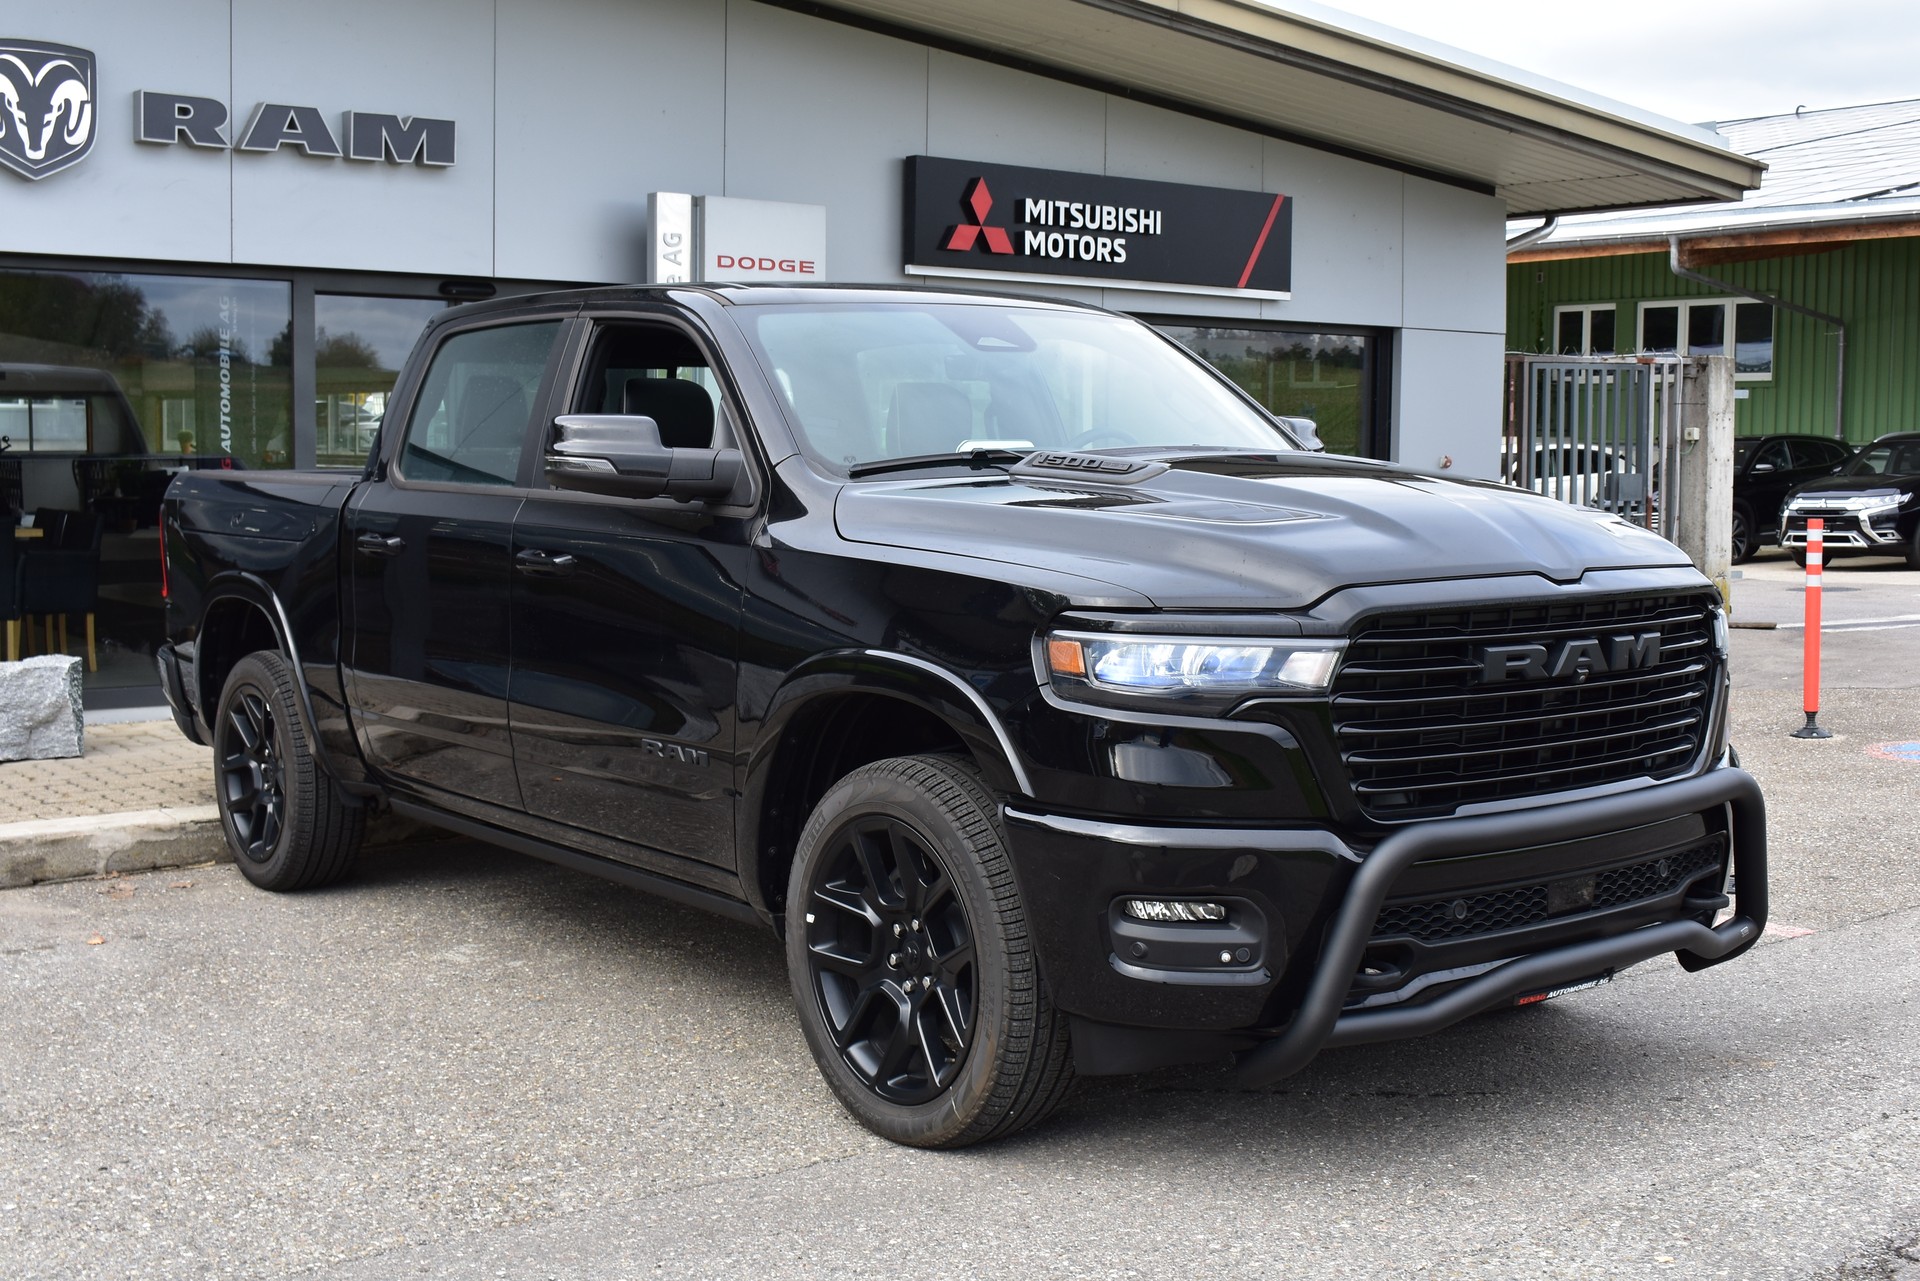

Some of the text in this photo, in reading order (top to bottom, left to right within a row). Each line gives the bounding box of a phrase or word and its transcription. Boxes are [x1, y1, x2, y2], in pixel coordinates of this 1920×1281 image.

[134, 89, 456, 166] RAM
[1025, 198, 1162, 235] MITSUBISHI
[662, 232, 683, 266] AG
[1024, 230, 1127, 263] MOTORS
[717, 255, 815, 274] DODGE
[219, 296, 230, 324] AG
[220, 328, 231, 453] AUTOMOBILE
[1483, 632, 1661, 683] RAM
[641, 738, 709, 768] RAM
[1547, 981, 1597, 998] AUTOMOBILE
[1598, 978, 1610, 986] AG
